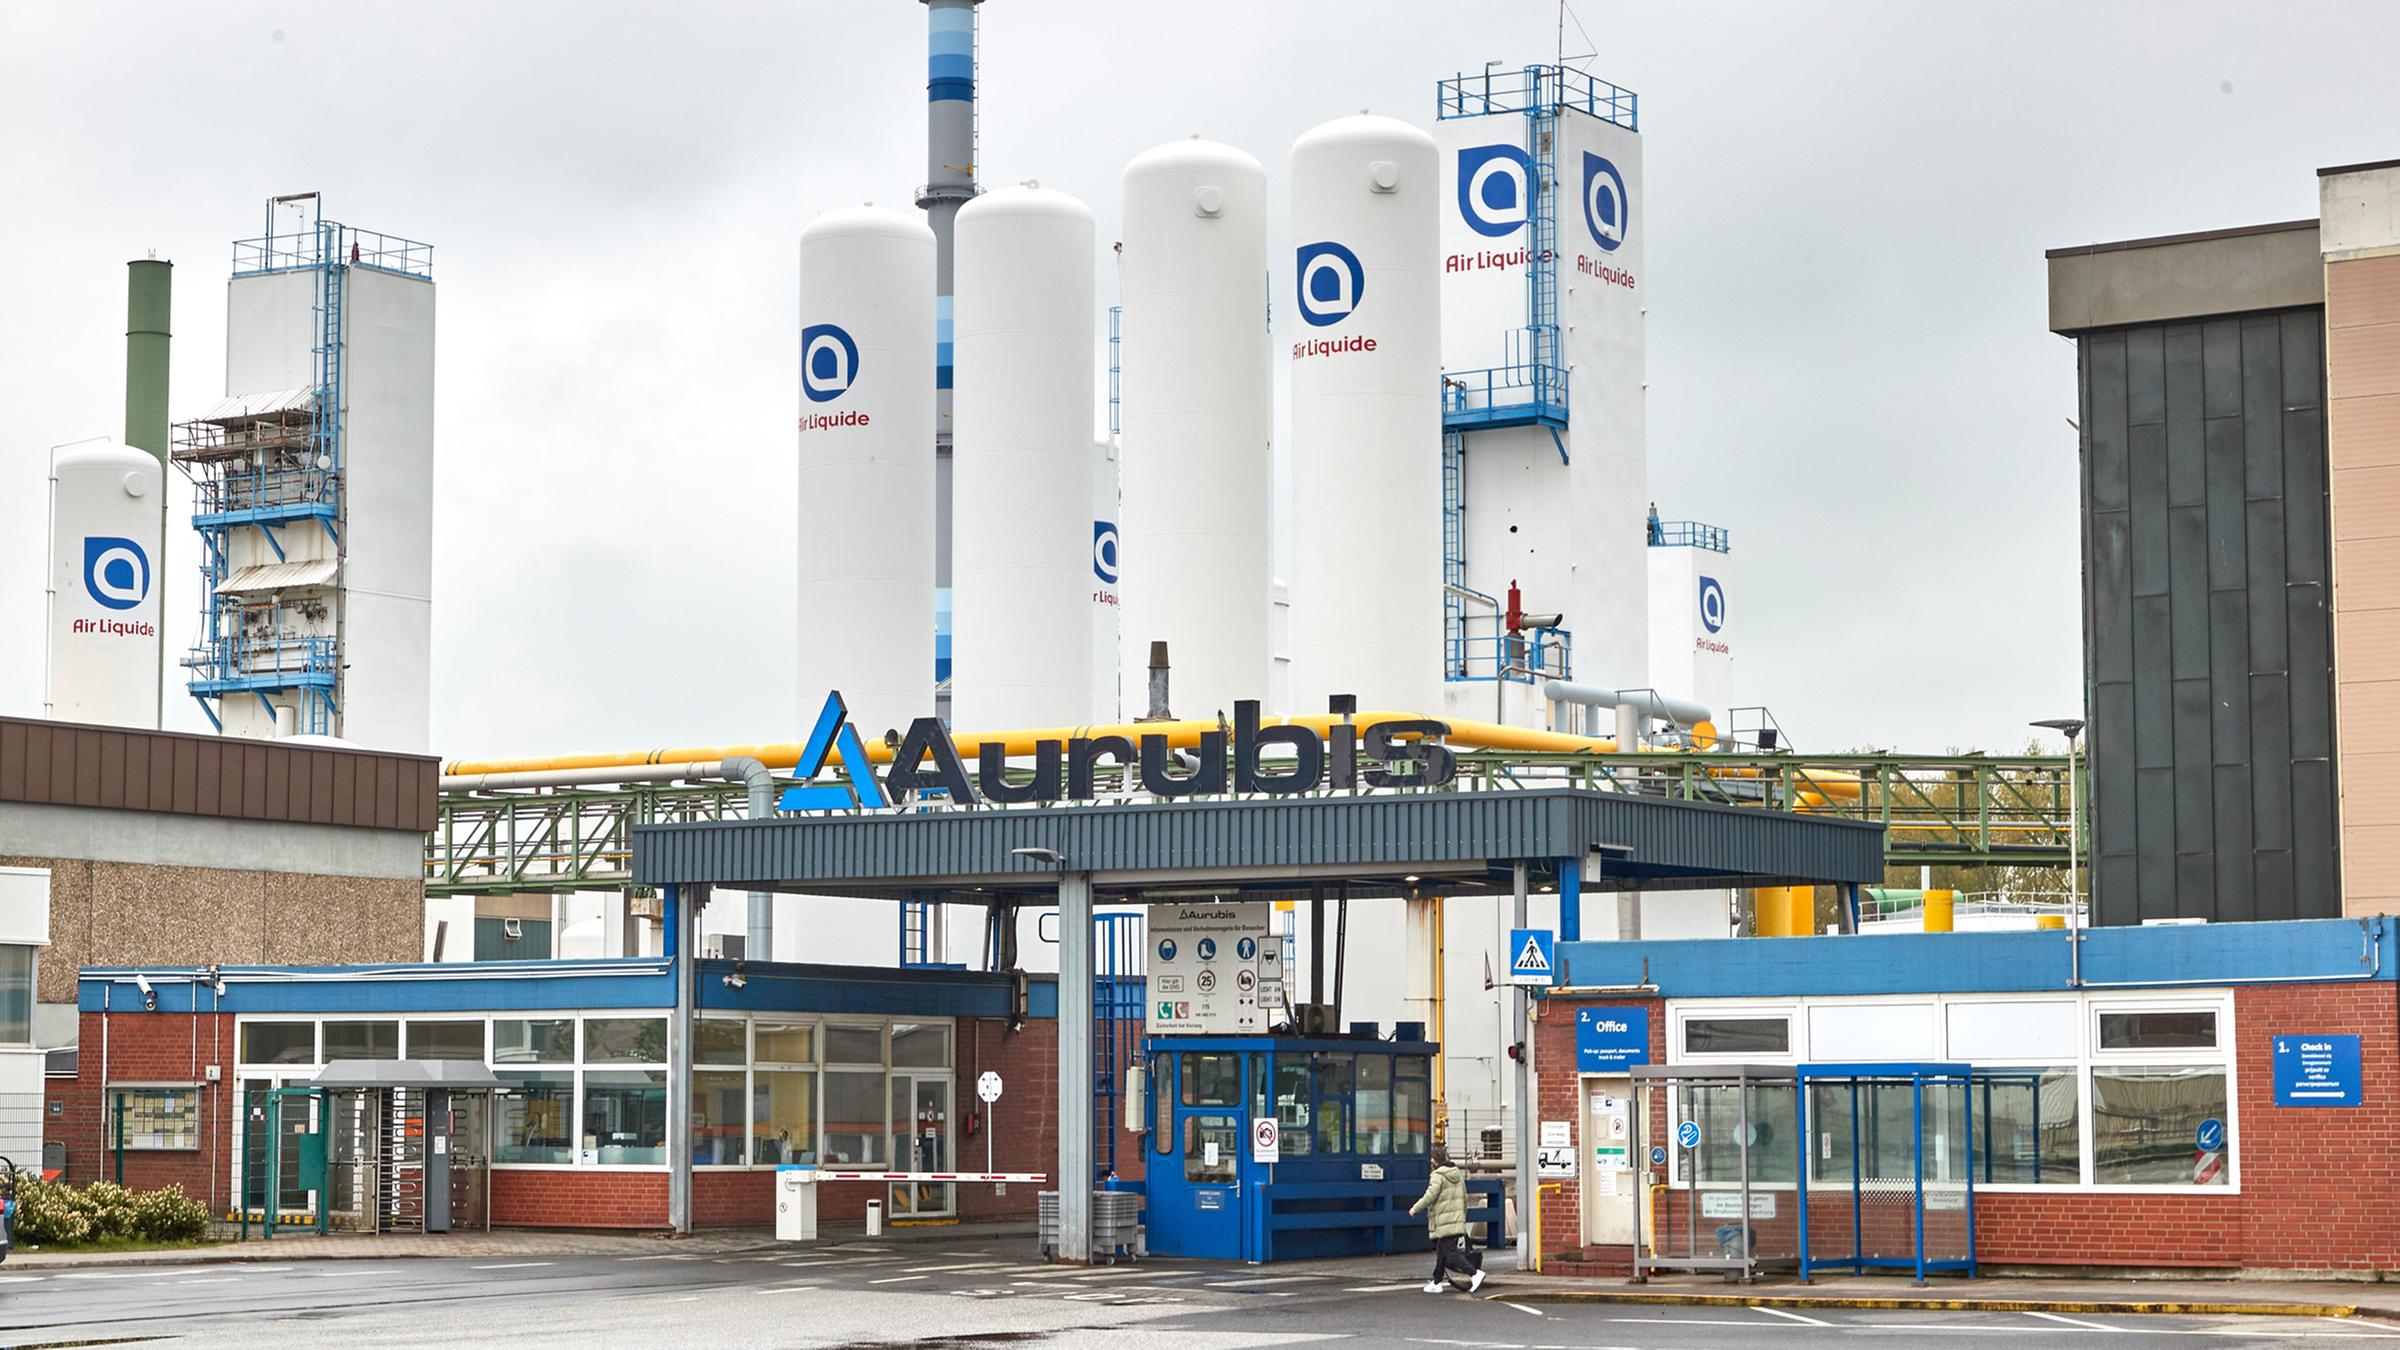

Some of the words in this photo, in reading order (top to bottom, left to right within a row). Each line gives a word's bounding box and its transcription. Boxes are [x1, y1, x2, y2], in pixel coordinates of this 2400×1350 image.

[1446, 255, 1473, 273] Air
[1577, 253, 1593, 275] Air
[1594, 258, 1635, 289] Liquide
[1293, 341, 1306, 360] Air
[1308, 335, 1377, 357] Liquide
[809, 411, 870, 431] Liquide
[73, 618, 96, 633] Air
[99, 618, 155, 637] Liquide
[1696, 637, 1705, 649] Air
[1706, 639, 1729, 655] Liquide
[887, 693, 1458, 805] Aurubis
[1188, 910, 1236, 919] Aurubis
[1201, 976, 1212, 987] 25
[1581, 1011, 1591, 1022] 2.
[1596, 1021, 1627, 1032] Office
[2278, 1041, 2290, 1053] 1.
[2301, 1043, 2323, 1051] Check
